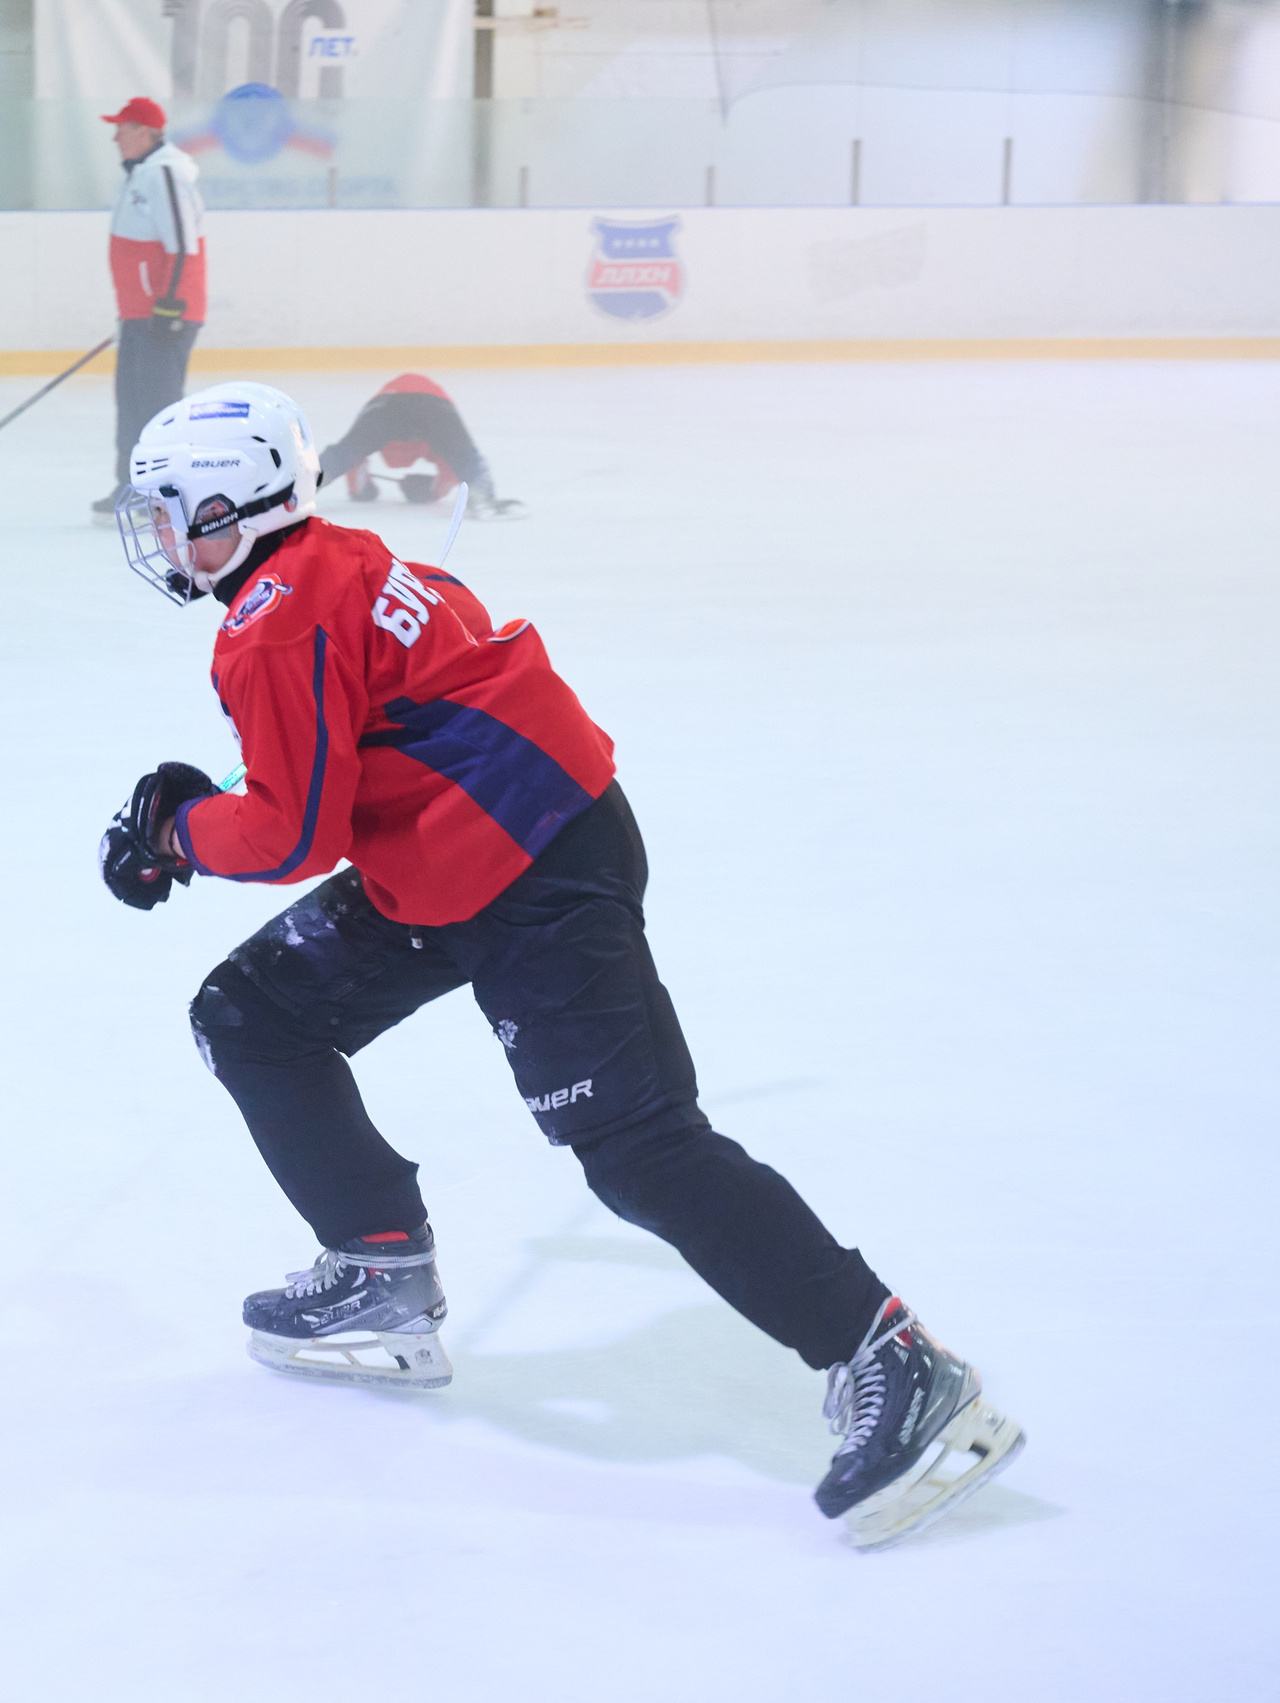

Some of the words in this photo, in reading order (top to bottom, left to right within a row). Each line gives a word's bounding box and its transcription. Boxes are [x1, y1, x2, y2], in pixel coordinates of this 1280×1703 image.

[191, 459, 241, 469] BAUER
[200, 511, 239, 534] BAUER
[371, 557, 445, 649] БУР
[524, 1079, 594, 1112] AUER
